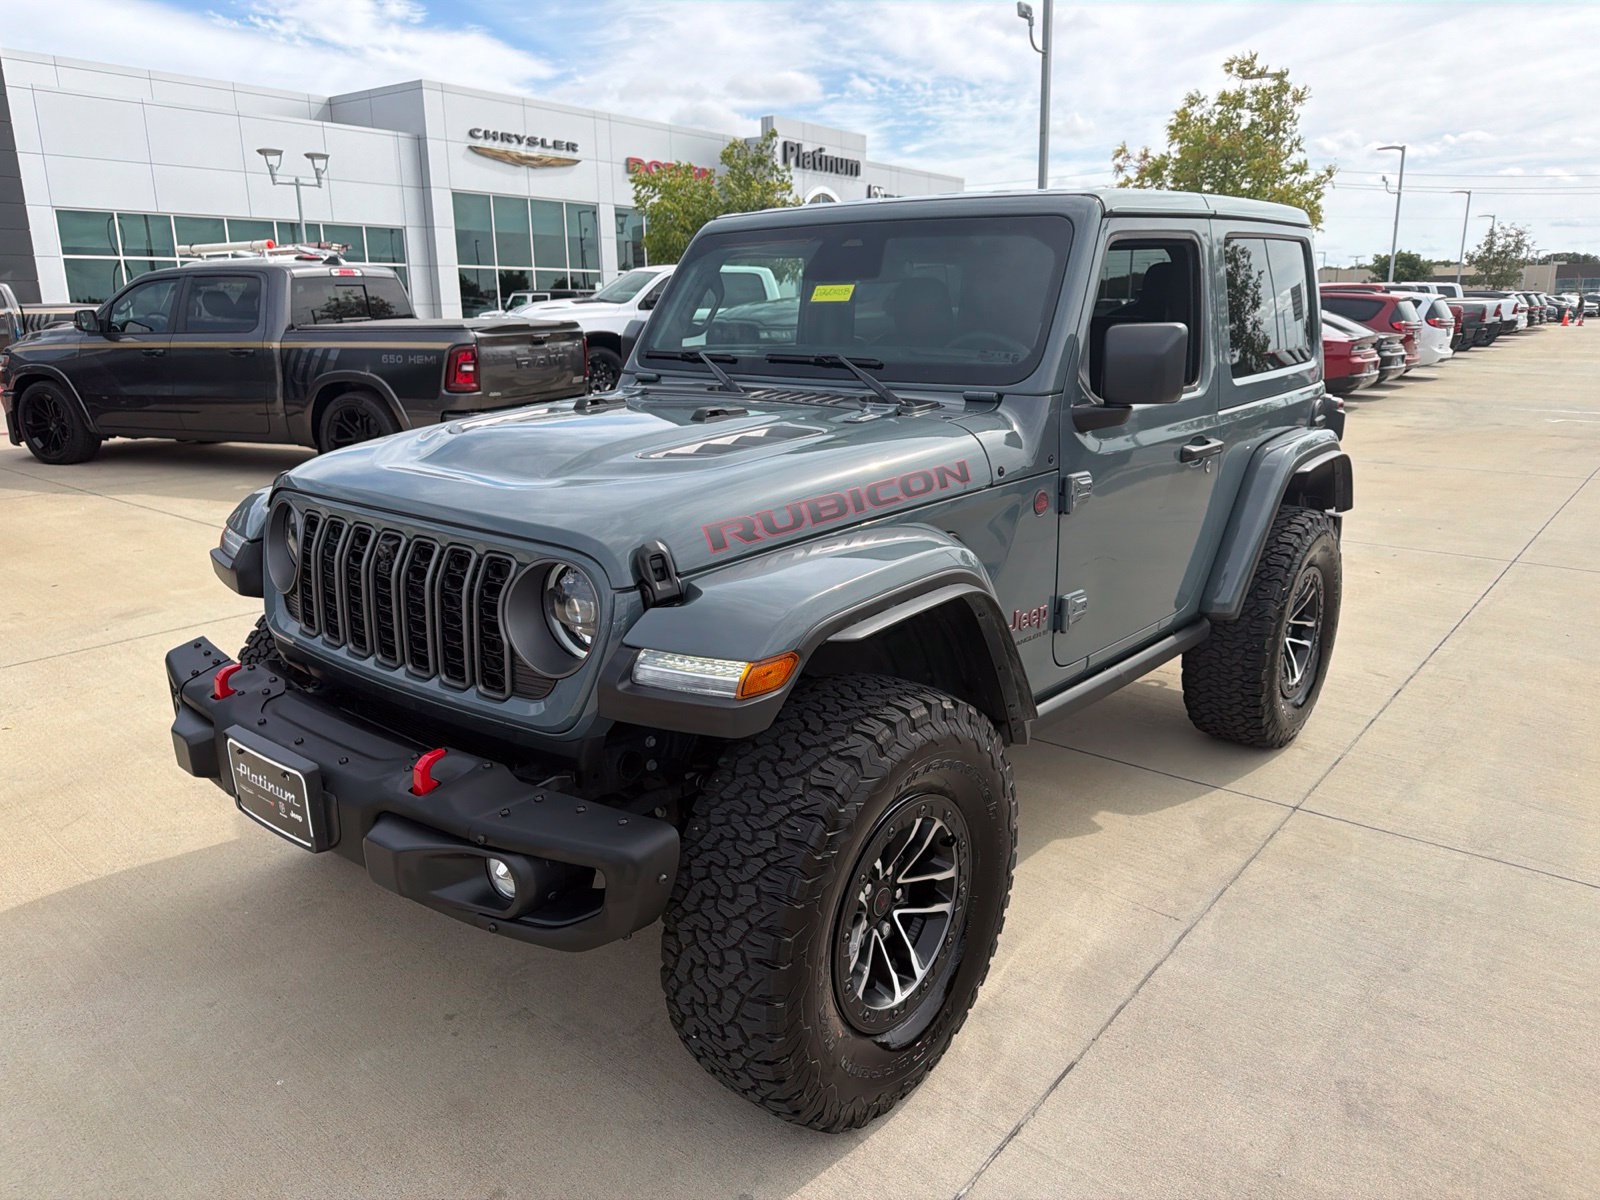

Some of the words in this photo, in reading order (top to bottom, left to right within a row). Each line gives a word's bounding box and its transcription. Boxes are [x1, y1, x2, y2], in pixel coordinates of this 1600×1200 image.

[468, 128, 579, 153] CHRYSLER
[782, 140, 861, 177] Platinum
[381, 354, 403, 364] 650
[408, 355, 437, 365] HEMI
[702, 459, 972, 554] RUBICON
[1009, 604, 1048, 632] Jeep
[236, 762, 301, 808] Platinum
